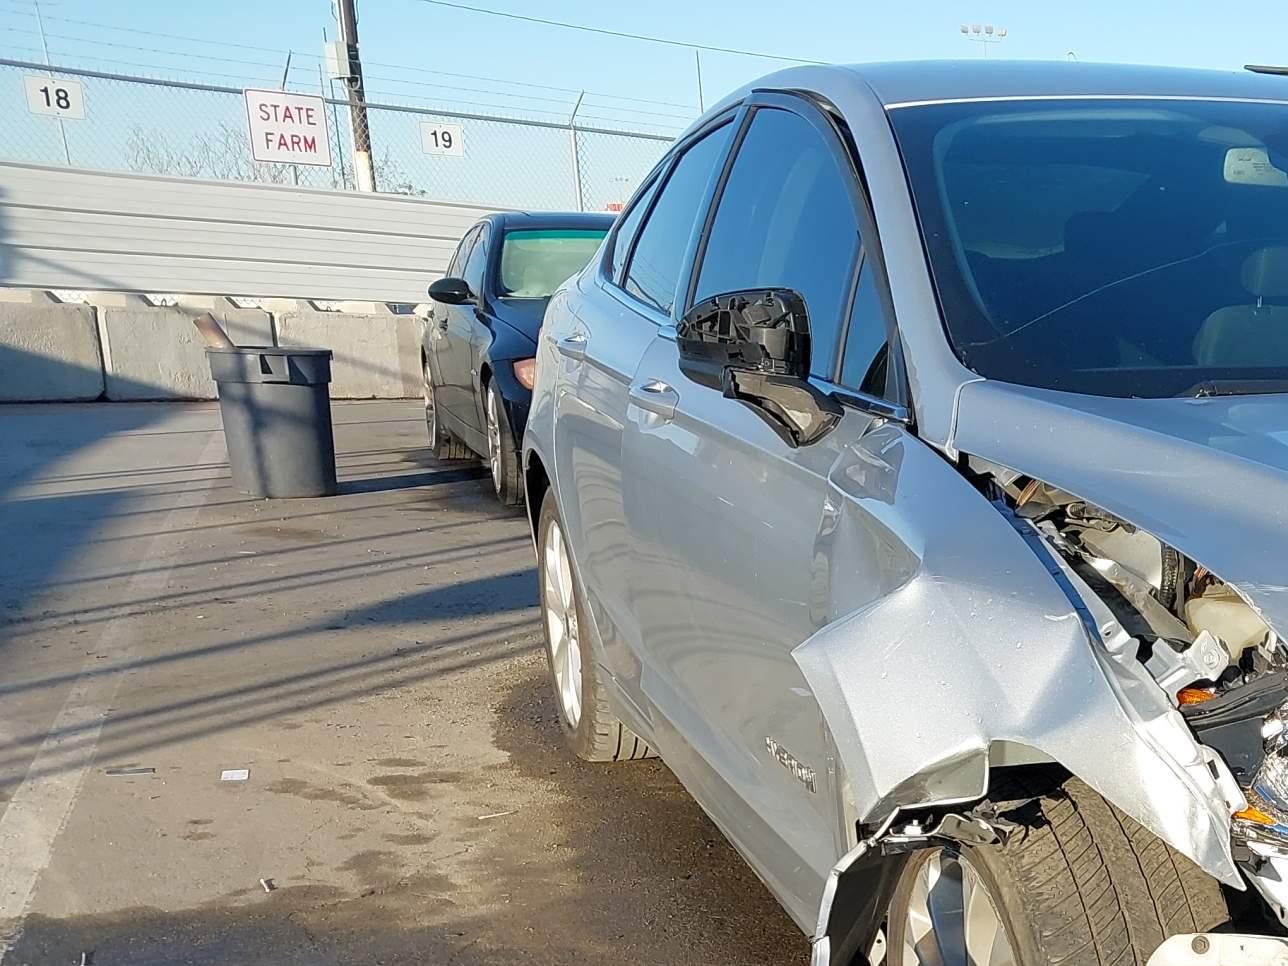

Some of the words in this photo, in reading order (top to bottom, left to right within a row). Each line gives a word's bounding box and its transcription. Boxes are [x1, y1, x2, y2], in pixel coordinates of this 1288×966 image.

[39, 86, 71, 110] 18
[259, 103, 317, 126] STATE
[265, 132, 318, 154] FARM
[430, 129, 453, 149] 19
